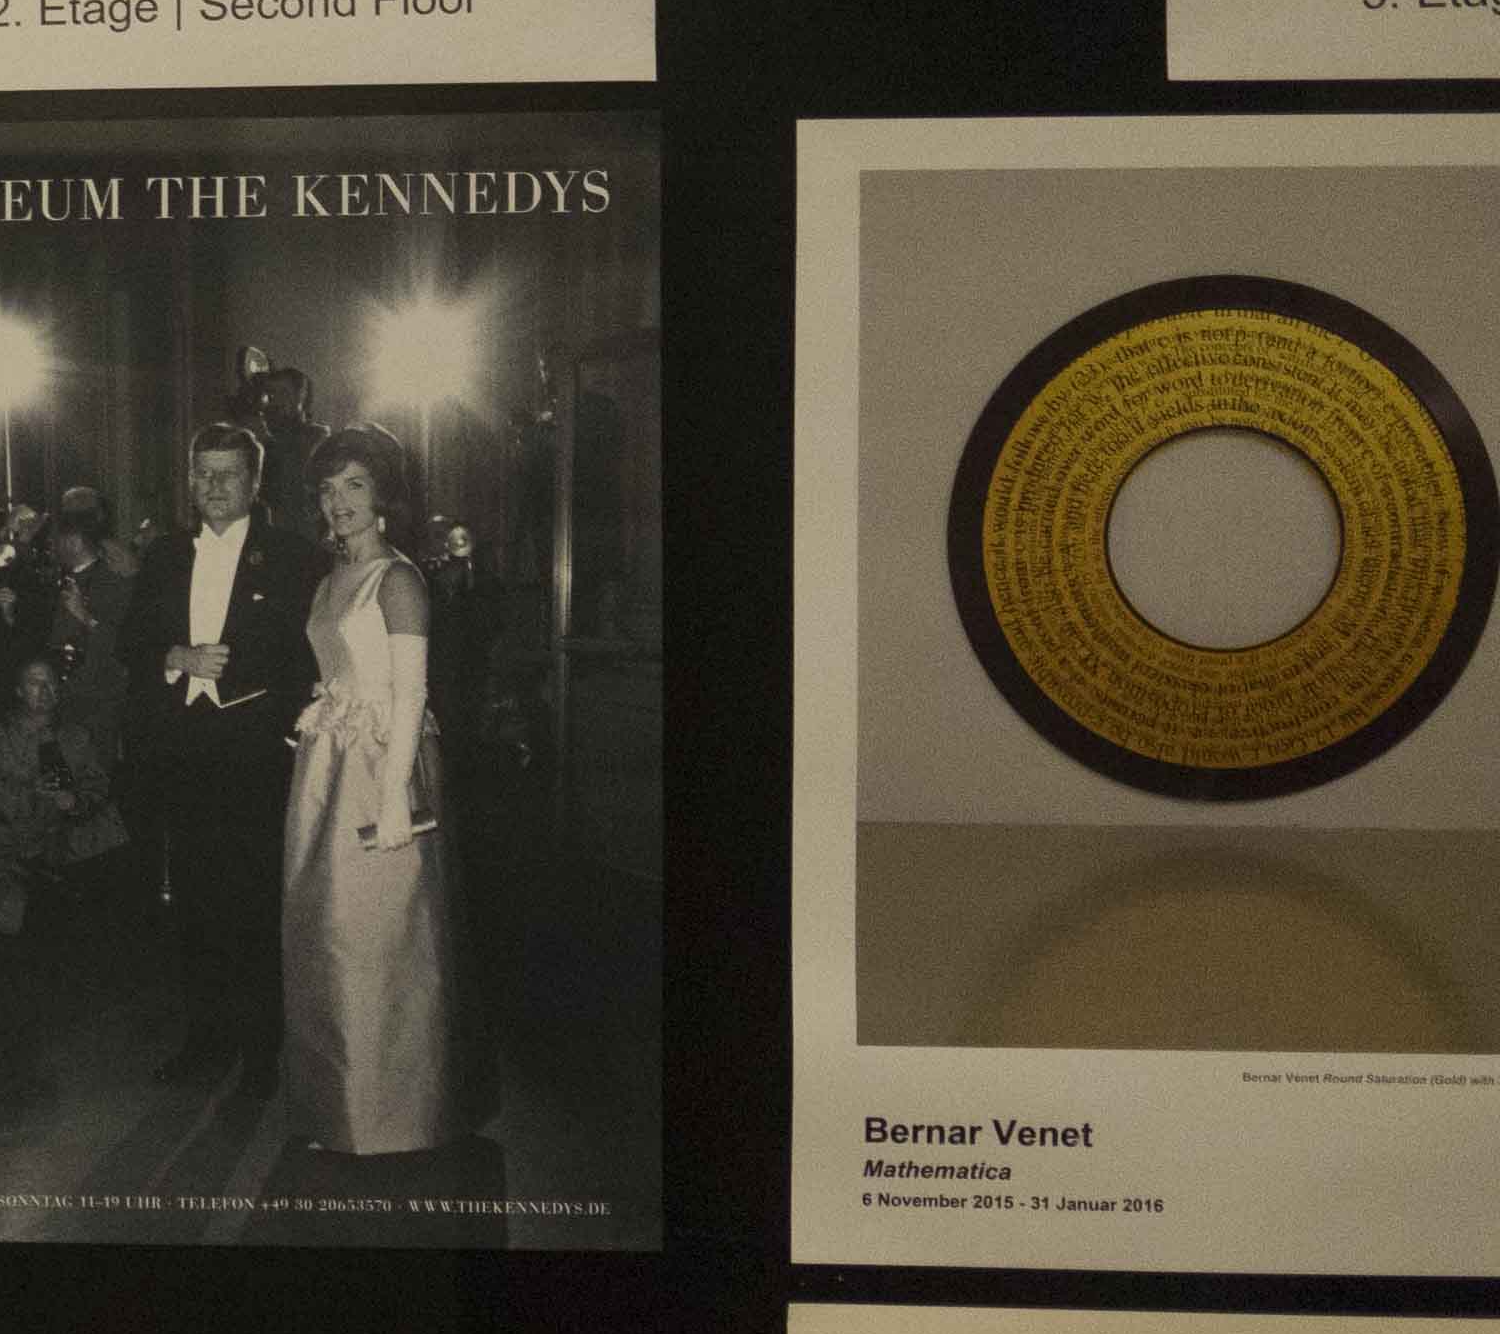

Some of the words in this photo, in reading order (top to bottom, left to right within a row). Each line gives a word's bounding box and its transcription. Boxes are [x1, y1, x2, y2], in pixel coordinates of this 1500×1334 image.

[146, 175, 267, 219] THE
[295, 170, 610, 217] KENNEDYS
[864, 1116, 983, 1145] Bernar
[992, 1119, 1093, 1148] Venet
[862, 1159, 1012, 1181] Mathematica
[861, 1192, 873, 1207] 6
[877, 1192, 968, 1209] November
[972, 1194, 1015, 1210] 2015
[1030, 1195, 1050, 1211] 31
[1055, 1196, 1117, 1212] Januar
[1122, 1197, 1164, 1213] 2016
